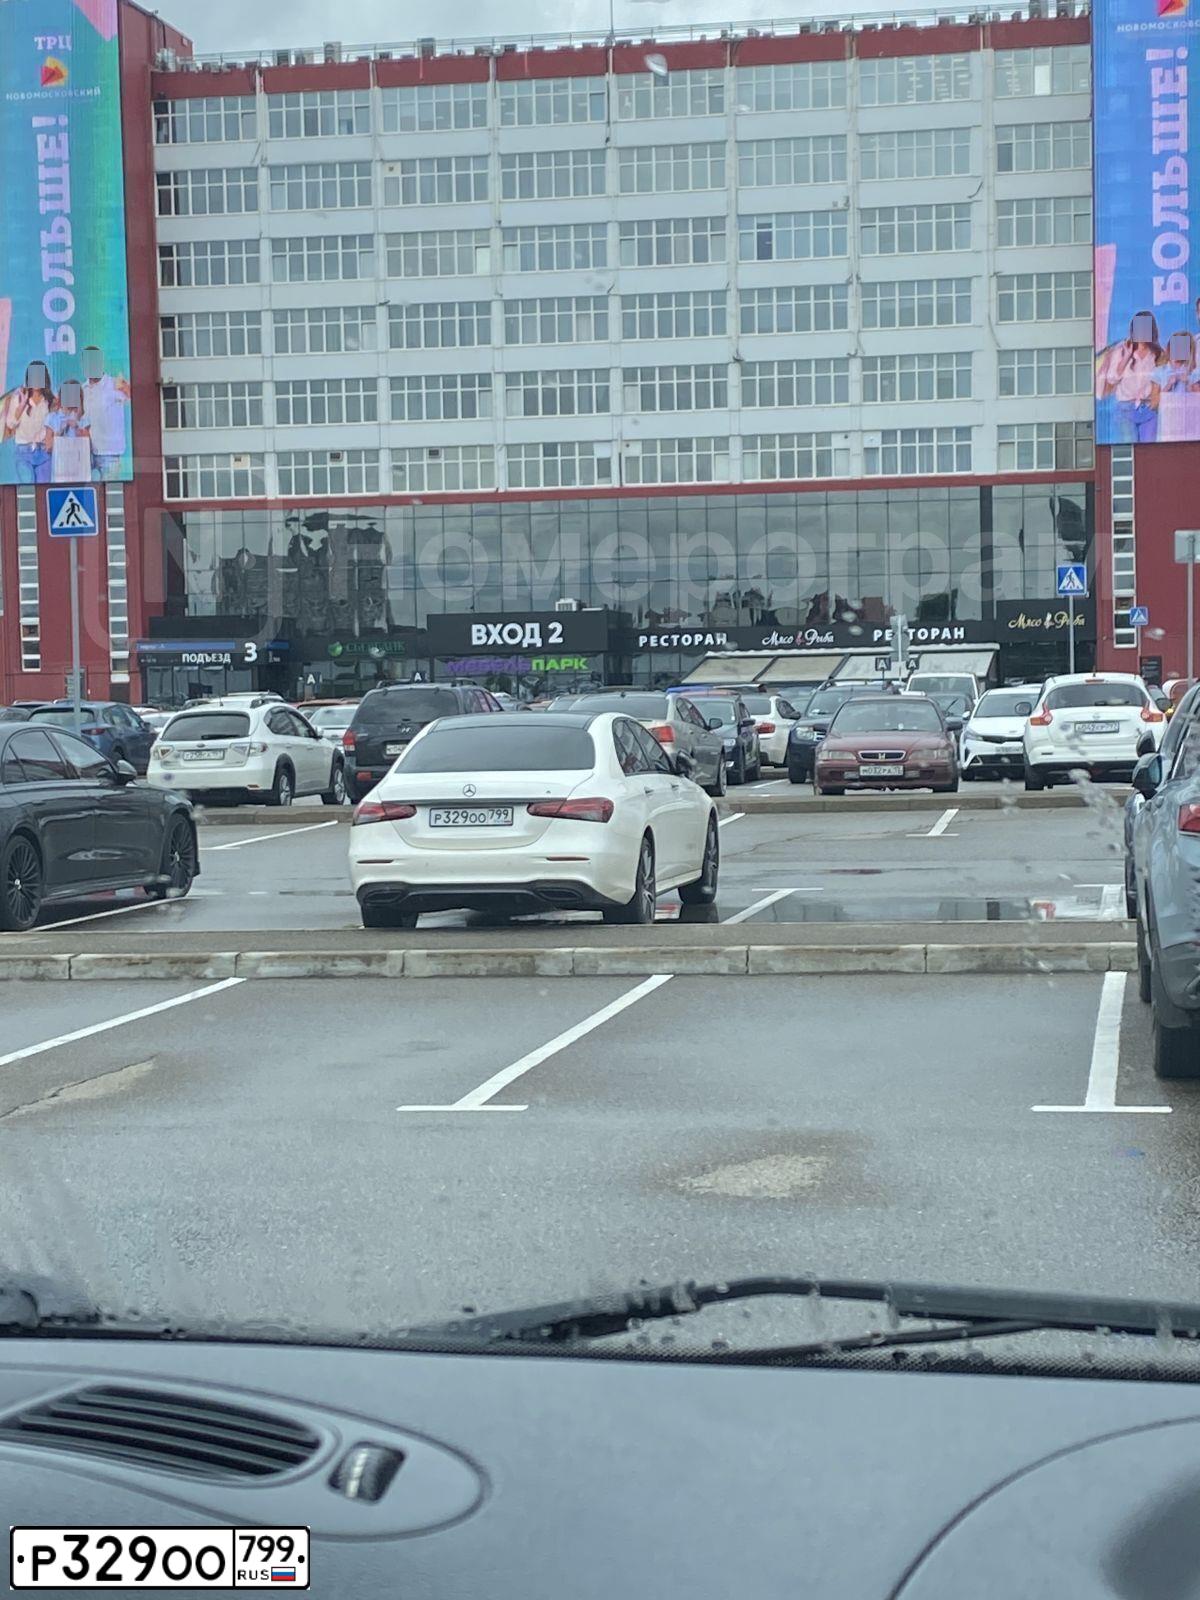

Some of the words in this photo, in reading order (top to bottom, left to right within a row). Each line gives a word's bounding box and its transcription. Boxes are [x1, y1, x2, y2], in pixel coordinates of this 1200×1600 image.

[34, 35, 72, 51] ТРЦ
[6, 87, 101, 101] НОВОМОСКОВСКИЙ
[1146, 47, 1190, 306] БОЛЬШЕ!
[32, 114, 76, 356] БОЛЬШЕ!
[471, 623, 542, 648] ВХОД
[549, 622, 563, 643] 2
[638, 632, 727, 648] РЕСТОРАН
[873, 627, 965, 641] РЕТОРАН
[182, 653, 231, 663] ПОДЪЕЗД
[244, 642, 258, 662] 3
[434, 810, 487, 824] Р329ОО
[488, 809, 509, 819] 799
